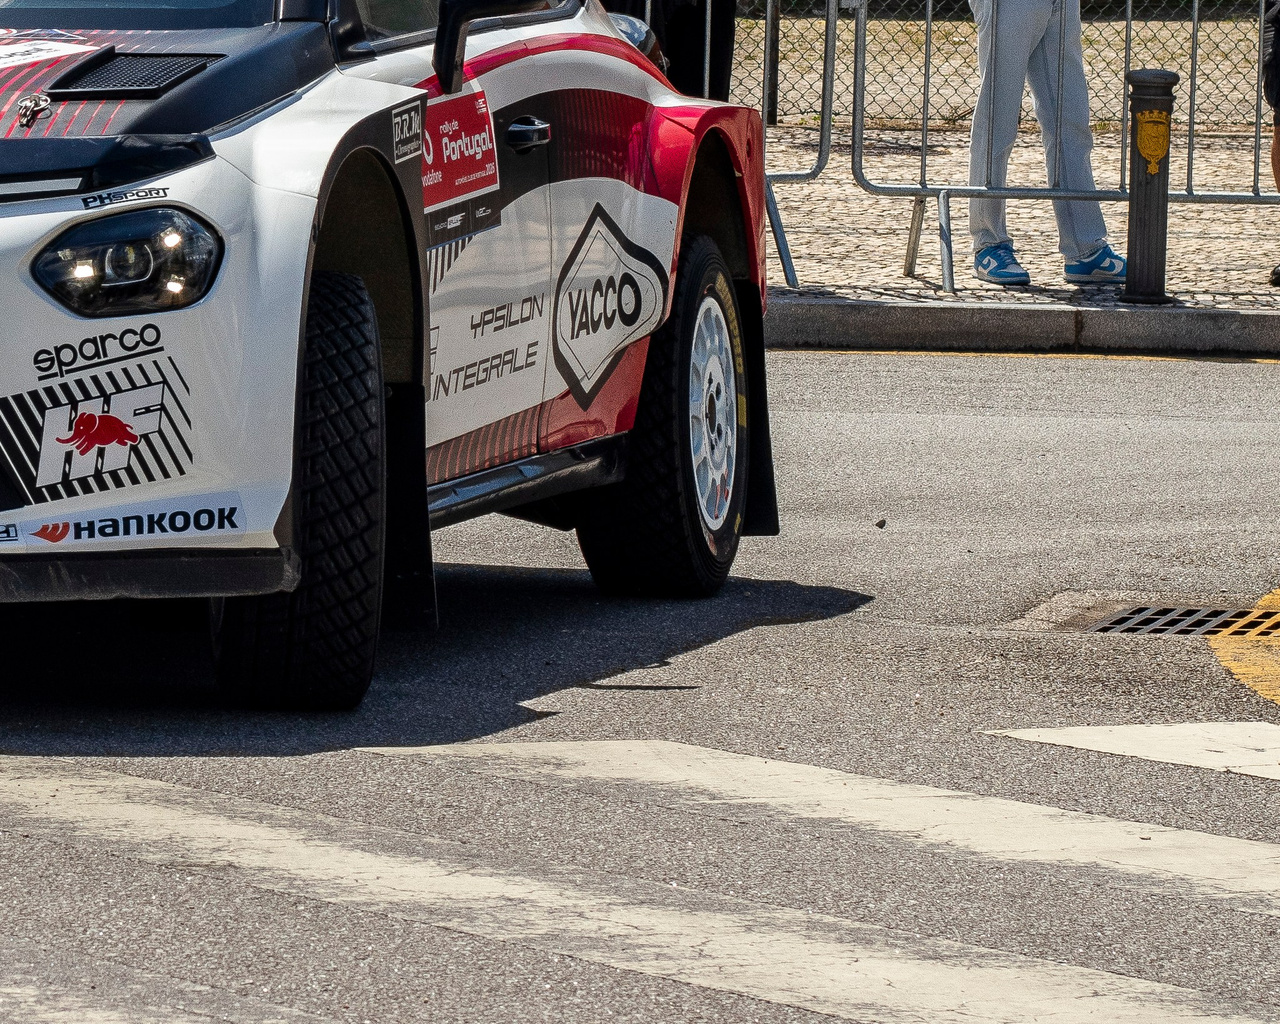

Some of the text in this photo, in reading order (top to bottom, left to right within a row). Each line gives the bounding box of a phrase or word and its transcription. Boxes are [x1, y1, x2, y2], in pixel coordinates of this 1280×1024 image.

[442, 125, 492, 164] Portugal
[81, 188, 170, 211] PHSPORT
[470, 292, 544, 339] YPSILON
[568, 272, 642, 341] YACCO
[33, 323, 161, 378] sparco
[432, 341, 539, 401] INTEGRALE
